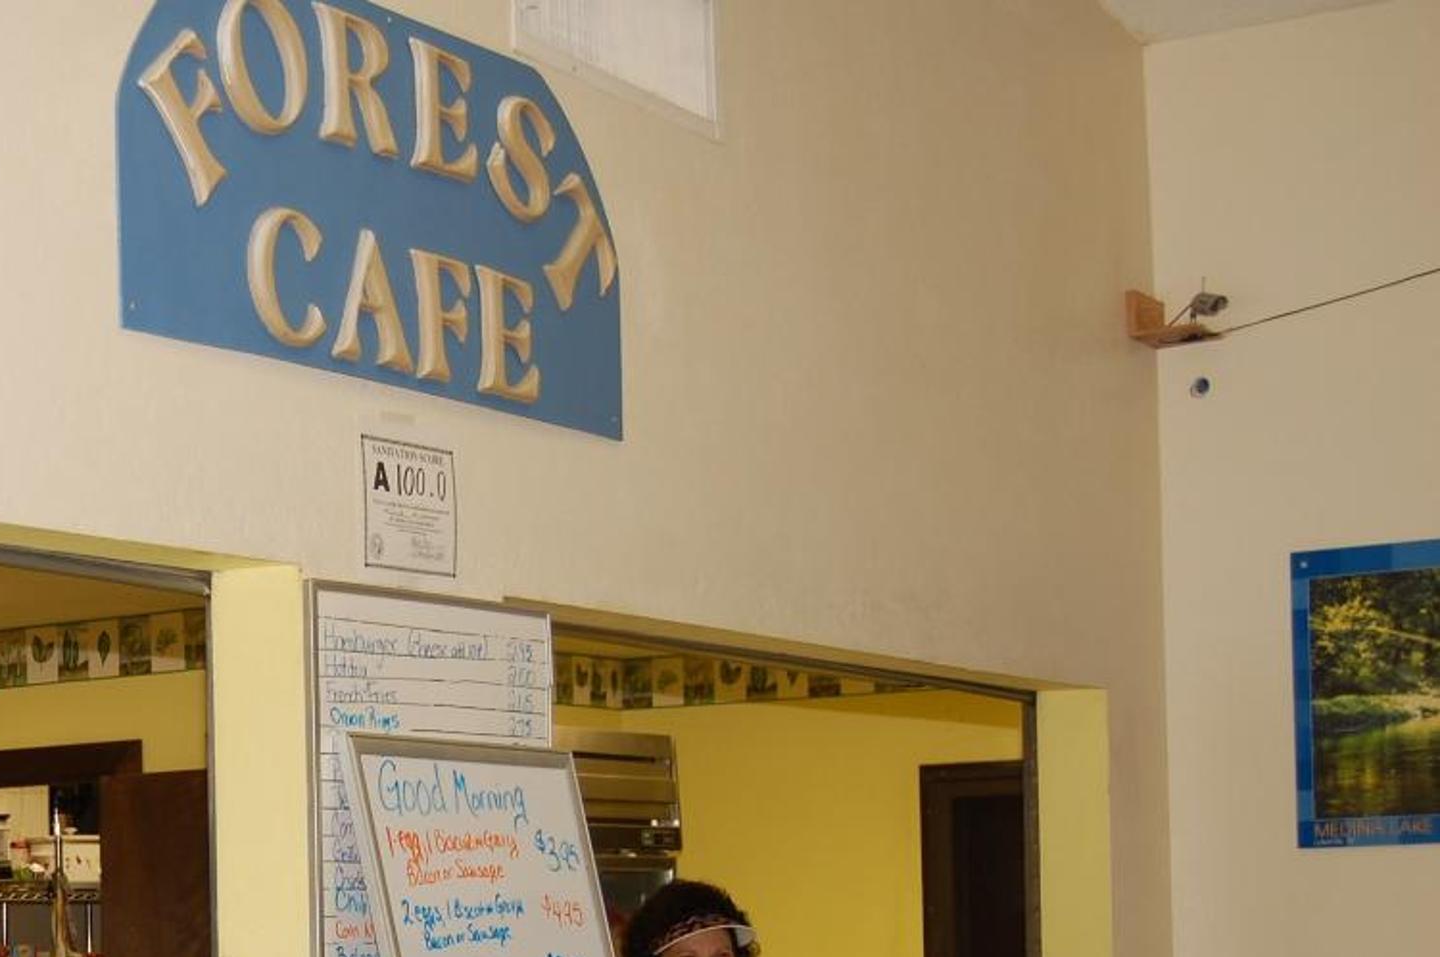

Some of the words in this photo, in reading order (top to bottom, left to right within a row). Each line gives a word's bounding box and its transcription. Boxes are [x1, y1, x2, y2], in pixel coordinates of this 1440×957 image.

[138, 0, 618, 310] FOREST
[247, 206, 541, 403] CAFE
[372, 461, 391, 492] A
[396, 463, 447, 501] 100.0
[378, 759, 447, 817] Good
[452, 769, 529, 831] Morning
